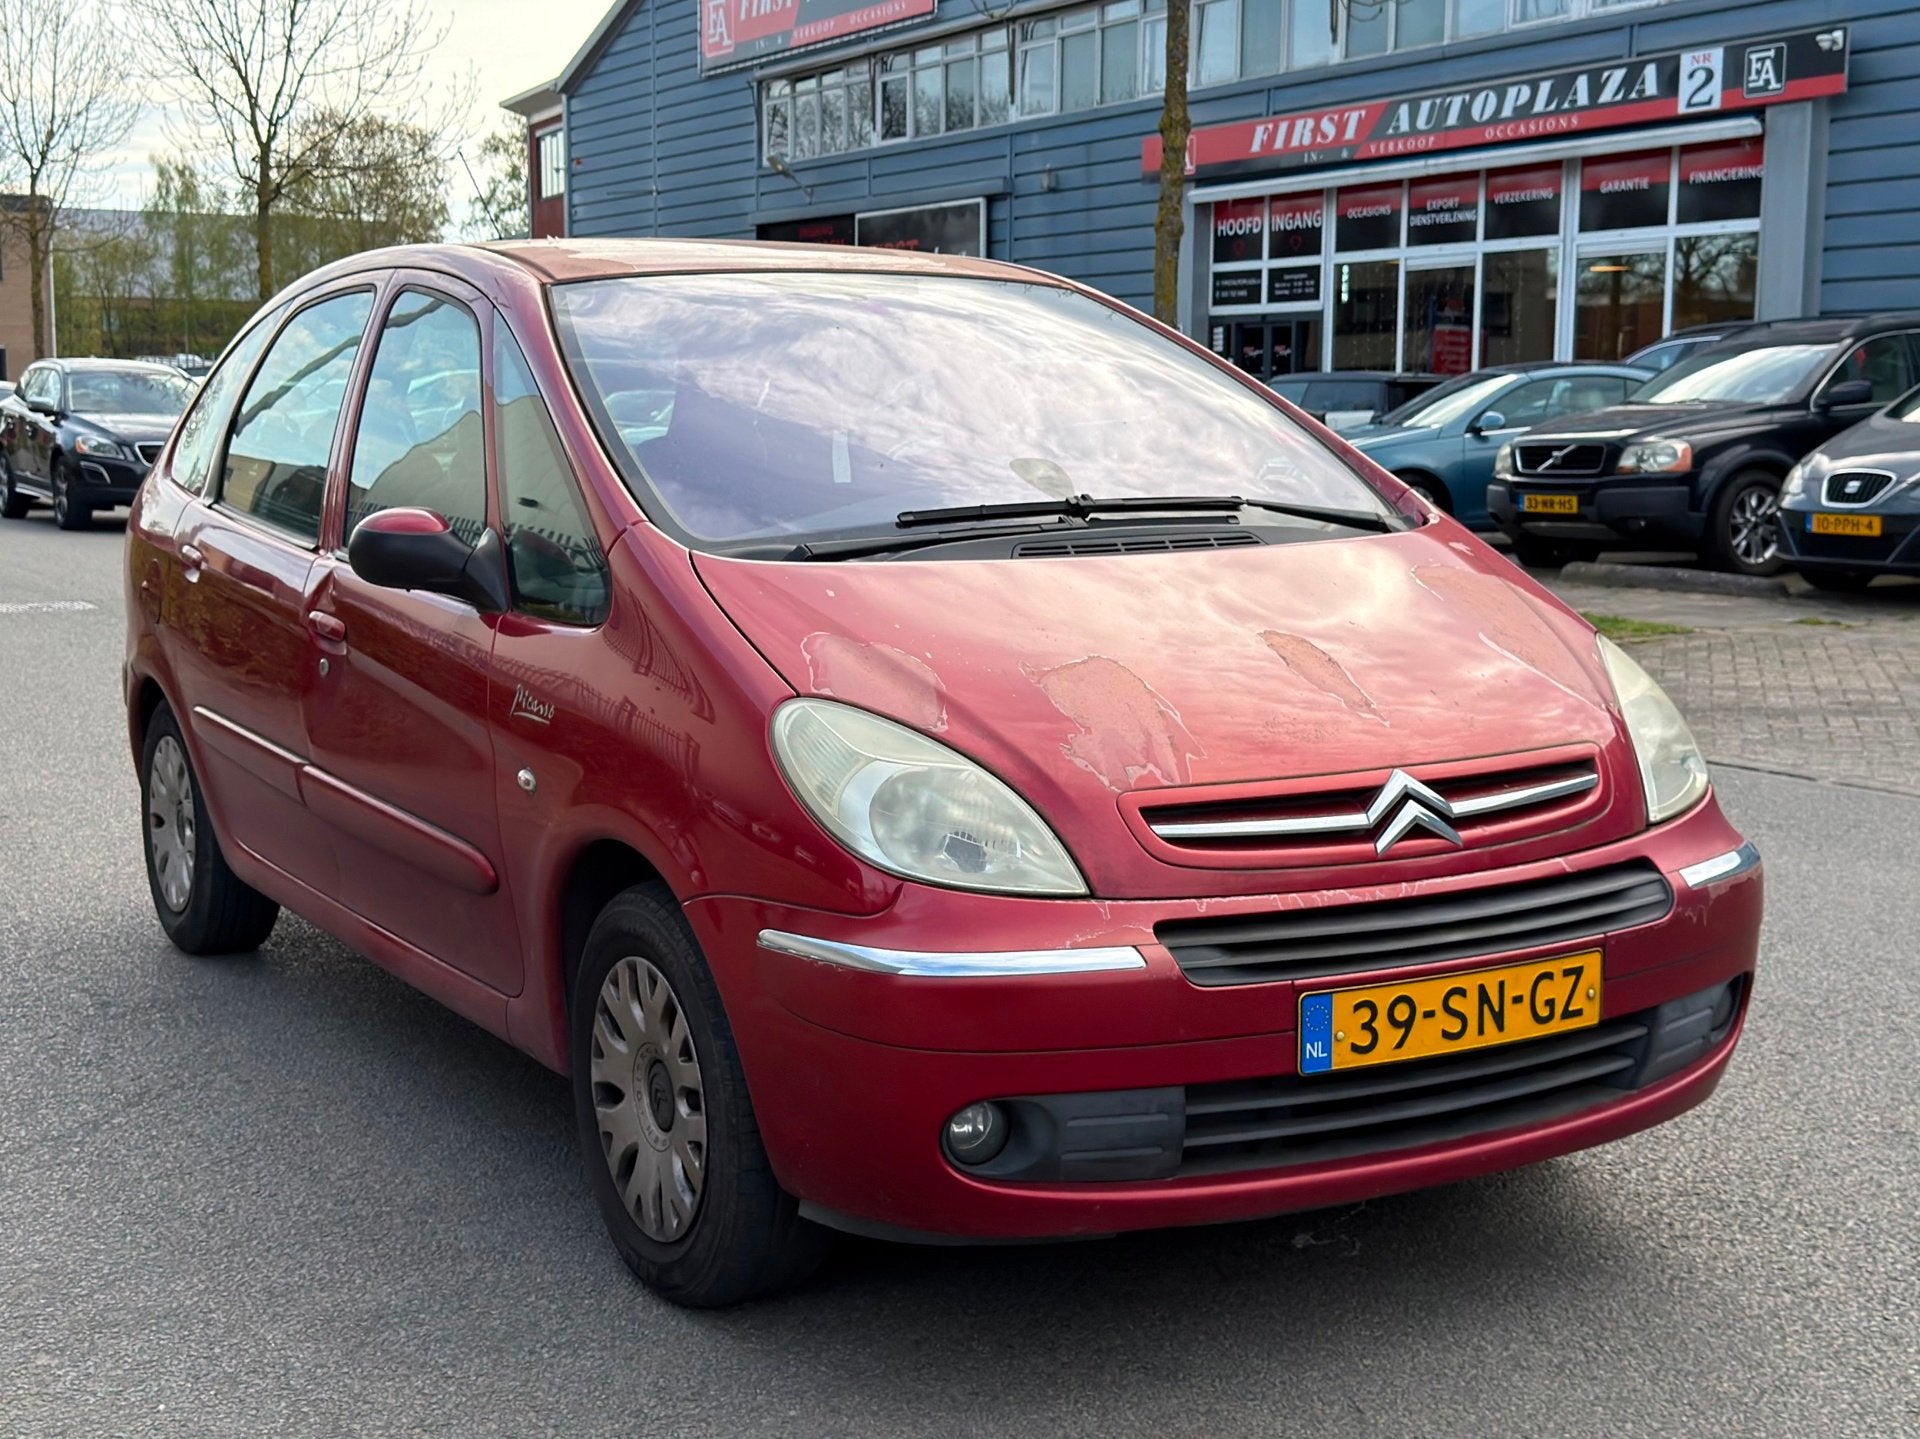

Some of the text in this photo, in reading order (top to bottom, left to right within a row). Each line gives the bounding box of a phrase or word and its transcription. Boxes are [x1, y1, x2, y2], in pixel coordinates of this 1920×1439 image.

[1691, 52, 1713, 67] NR
[1748, 48, 1782, 90] FA
[1685, 66, 1715, 109] 2
[1250, 63, 1660, 153] FIRST AUTOPLAZA
[1370, 136, 1435, 155] VERKOOP
[1485, 115, 1580, 140] OCCASIONS
[1601, 176, 1650, 194] GARANTIE
[1689, 164, 1764, 185] FINANCIERING
[1426, 197, 1460, 212] EXPORT
[1493, 187, 1554, 205] VERZEKERING
[1347, 205, 1392, 219] OCCASIONS
[1410, 210, 1477, 227] DIENSTVERLENING
[1217, 209, 1322, 237] HOOFD INGANG
[510, 683, 556, 722] Picasso
[1350, 965, 1585, 1055] 39-SN-GZ
[1305, 1042, 1328, 1059] NL
